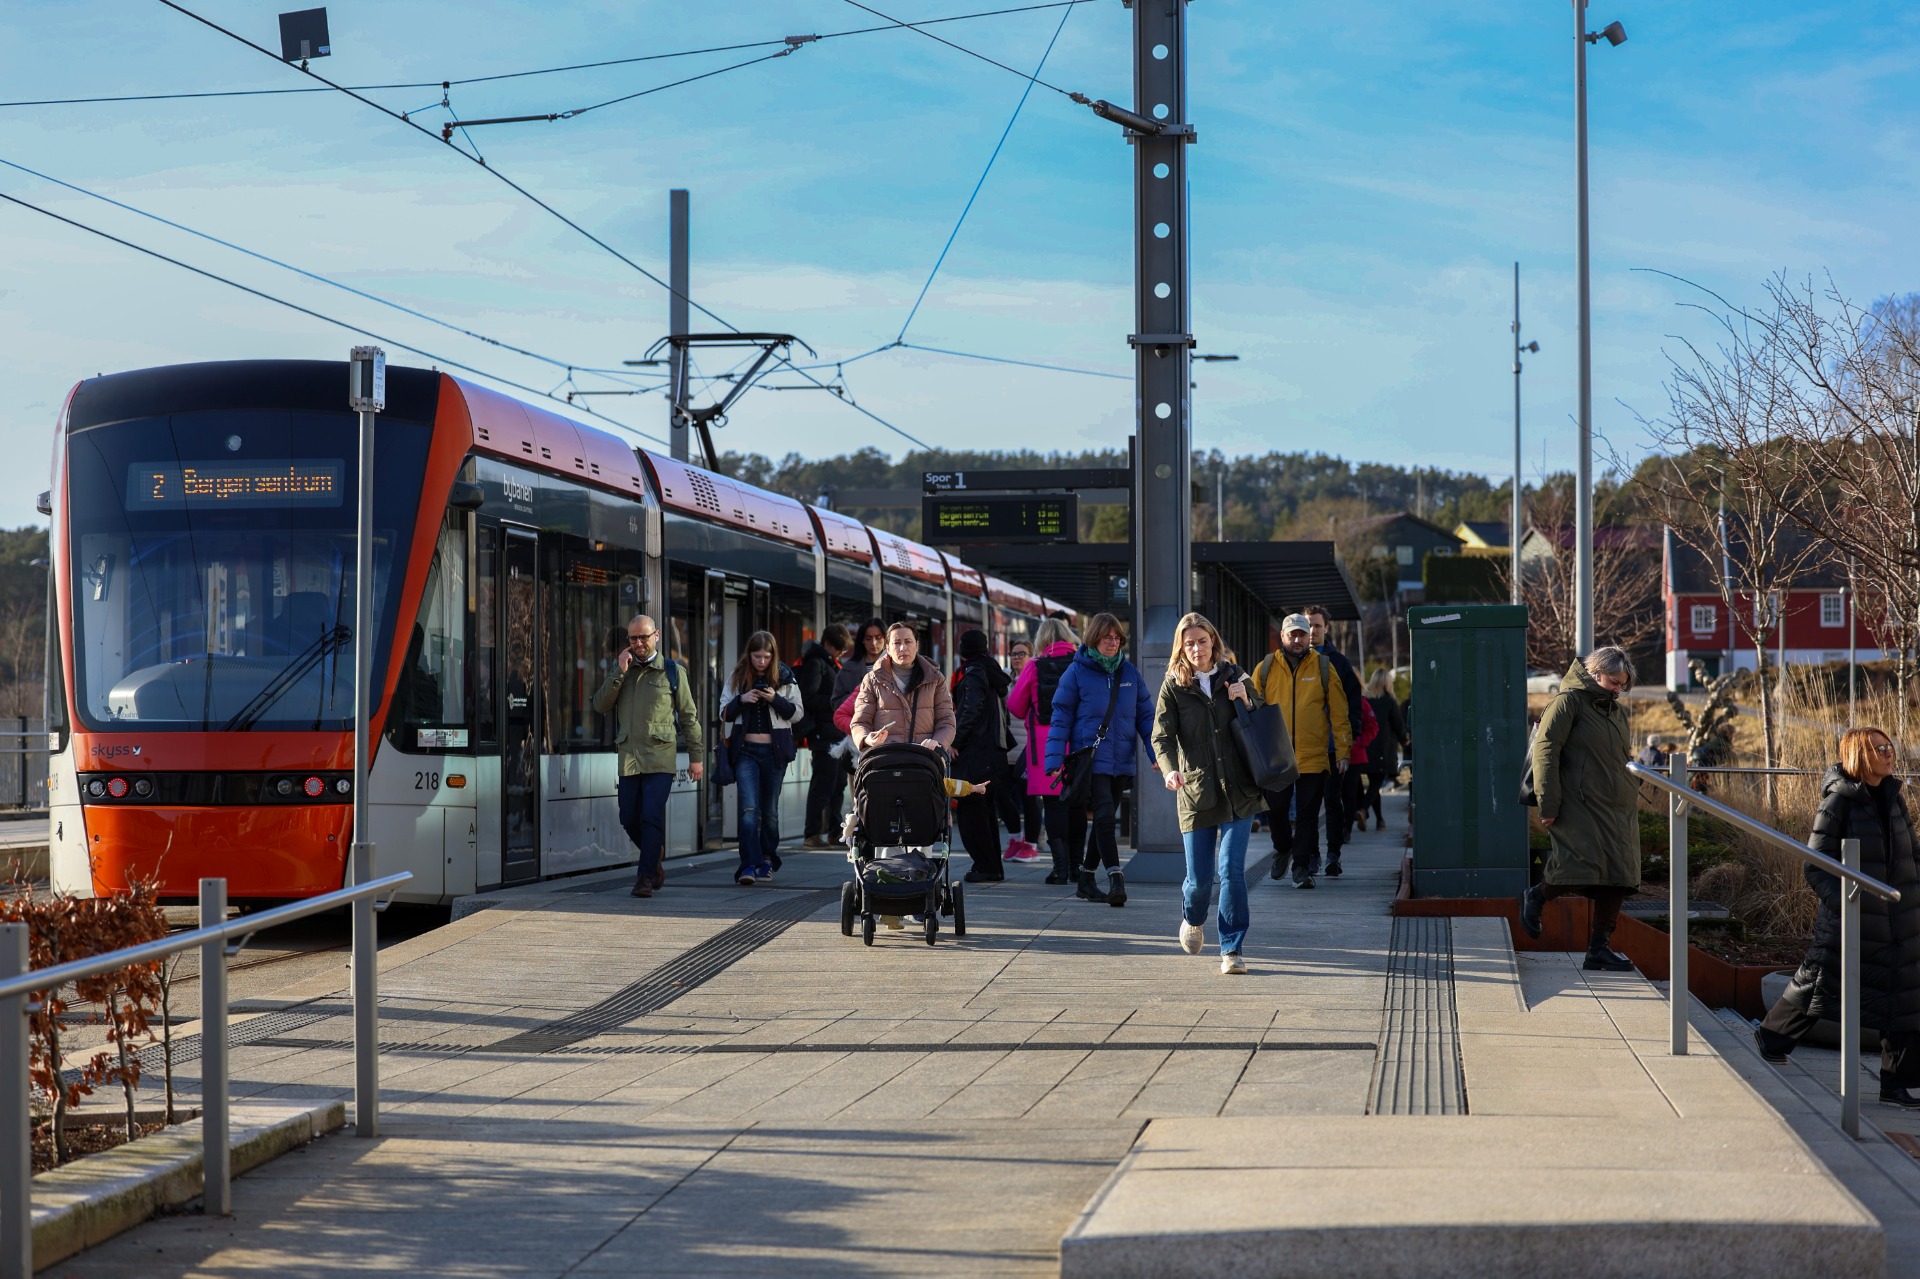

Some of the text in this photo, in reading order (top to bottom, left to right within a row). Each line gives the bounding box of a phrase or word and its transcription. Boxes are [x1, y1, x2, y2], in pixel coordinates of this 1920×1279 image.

[153, 466, 332, 498] 2 Bergen sentrum
[503, 473, 533, 503] bybanen
[926, 472, 967, 489] Spor 1
[940, 512, 962, 520] Bergen
[940, 519, 962, 528] Bergen
[91, 743, 129, 759] skyss
[415, 771, 439, 790] 218
